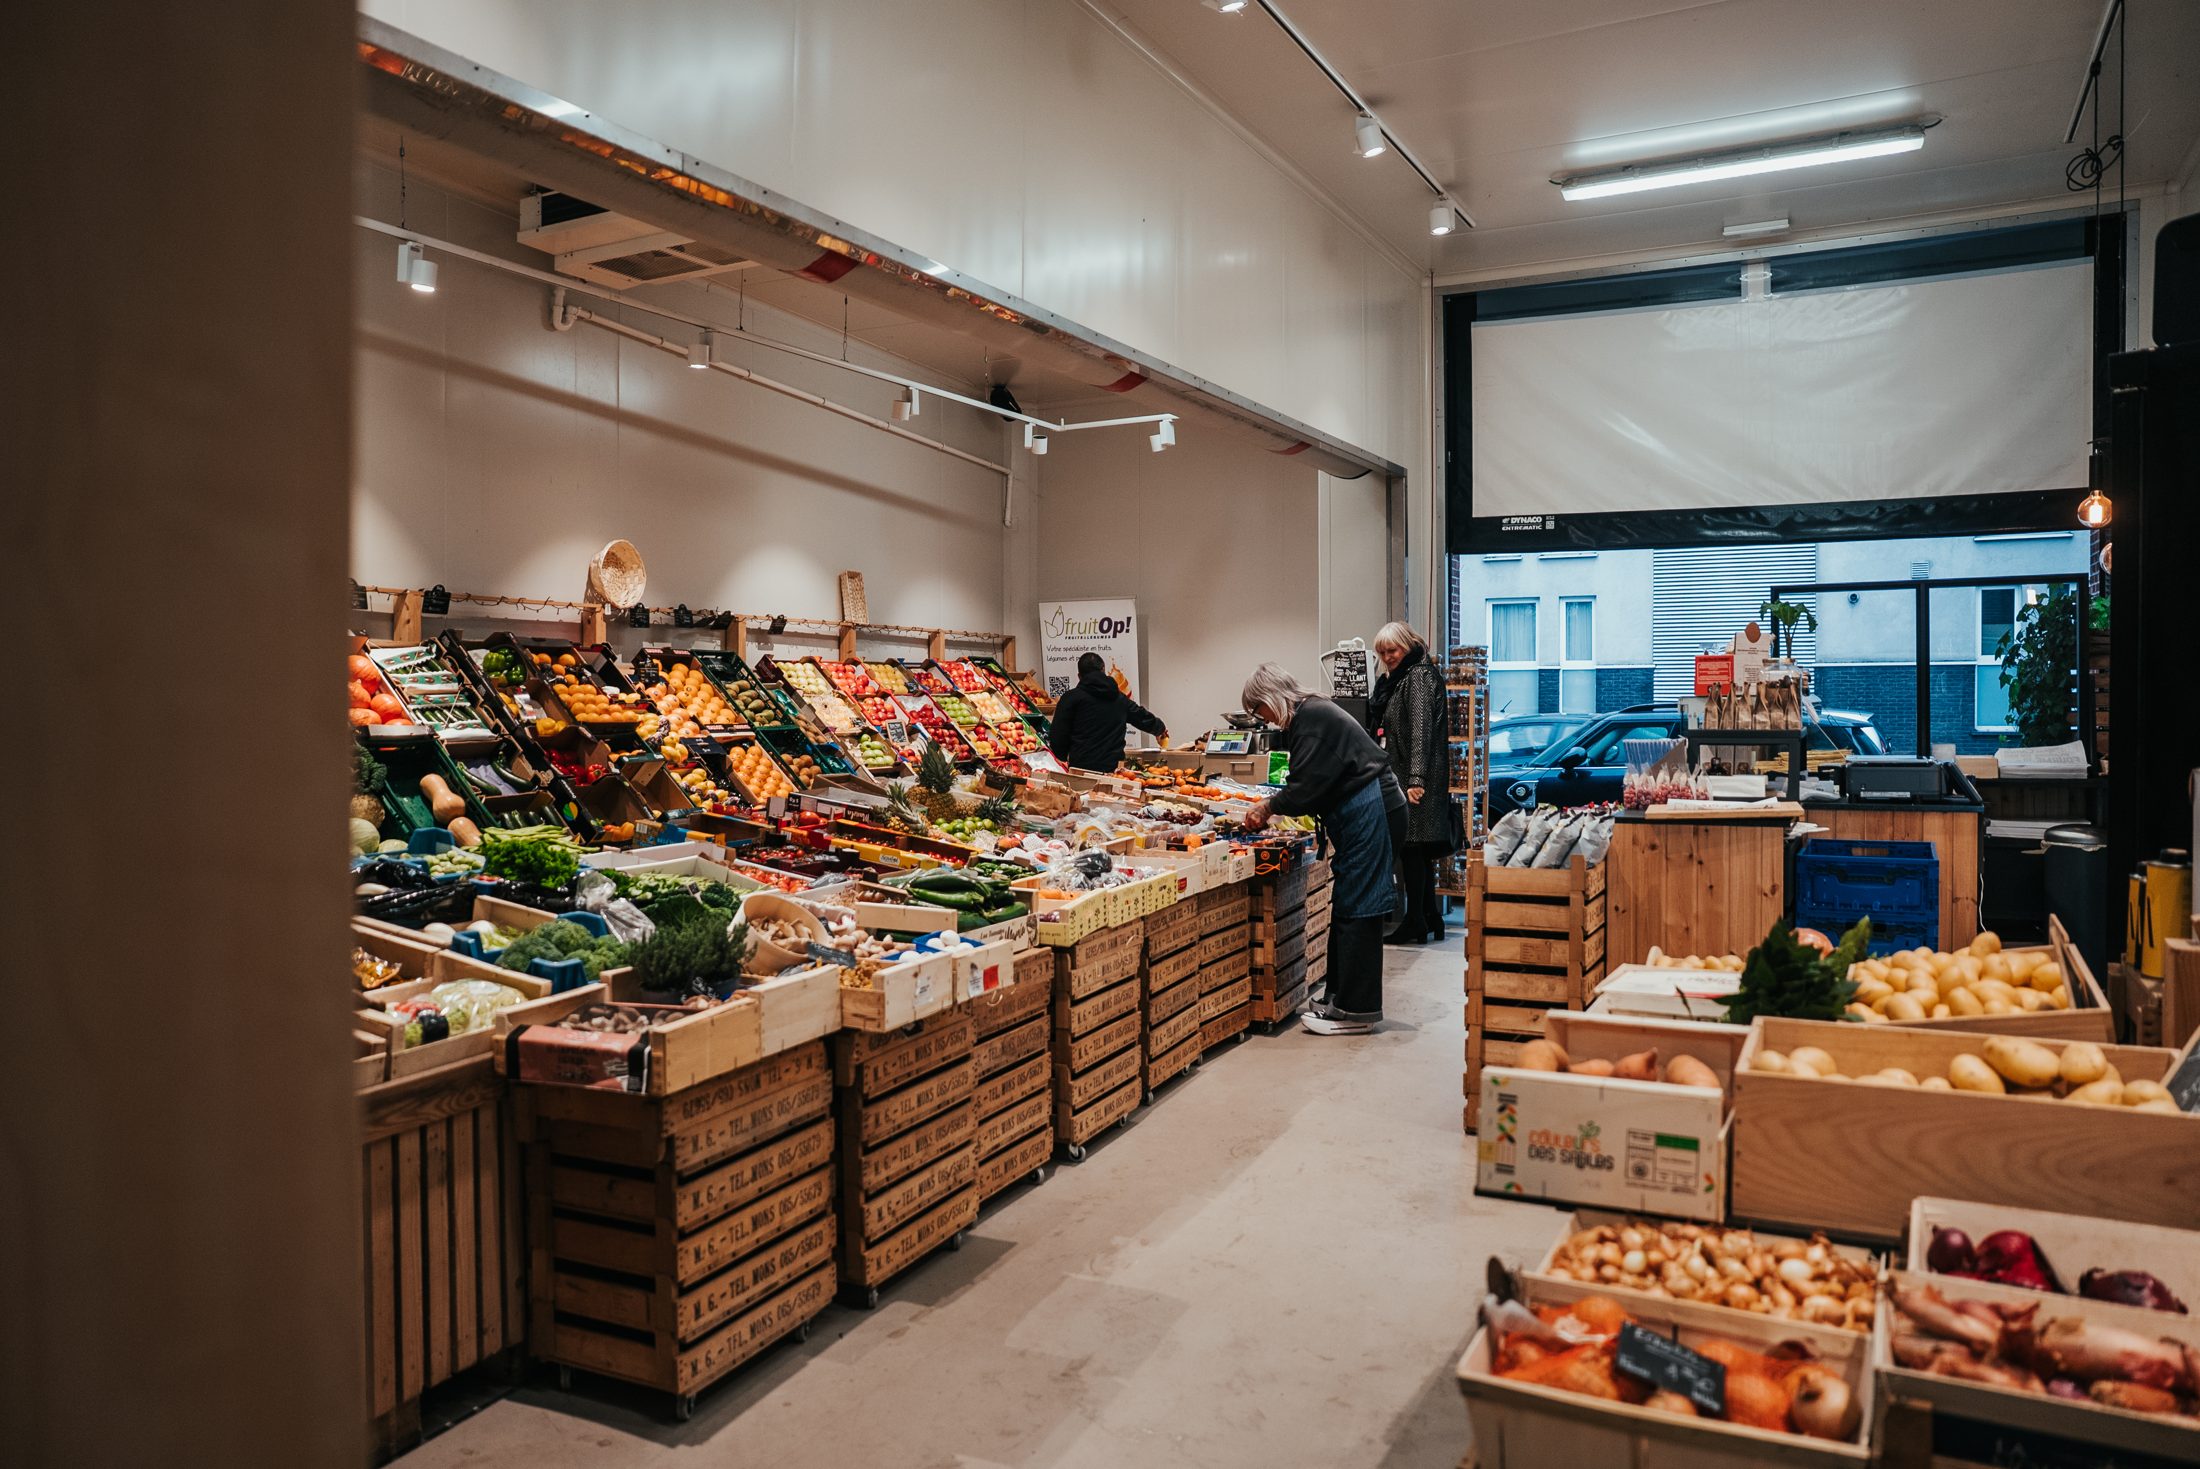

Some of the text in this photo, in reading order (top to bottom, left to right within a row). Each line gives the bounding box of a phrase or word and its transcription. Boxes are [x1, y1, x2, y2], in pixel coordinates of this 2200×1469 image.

[1065, 616, 1132, 638] fruitOp!
[914, 1042, 933, 1062] MONS
[917, 1088, 934, 1107] MONS
[751, 1103, 773, 1128] MONS
[916, 1133, 933, 1153] MONS
[751, 1157, 775, 1183] MONS
[918, 1179, 935, 1201] MONS
[752, 1205, 776, 1232] MONS
[917, 1223, 935, 1243] MONS
[752, 1258, 776, 1287] MONS
[749, 1311, 774, 1340] MONS
